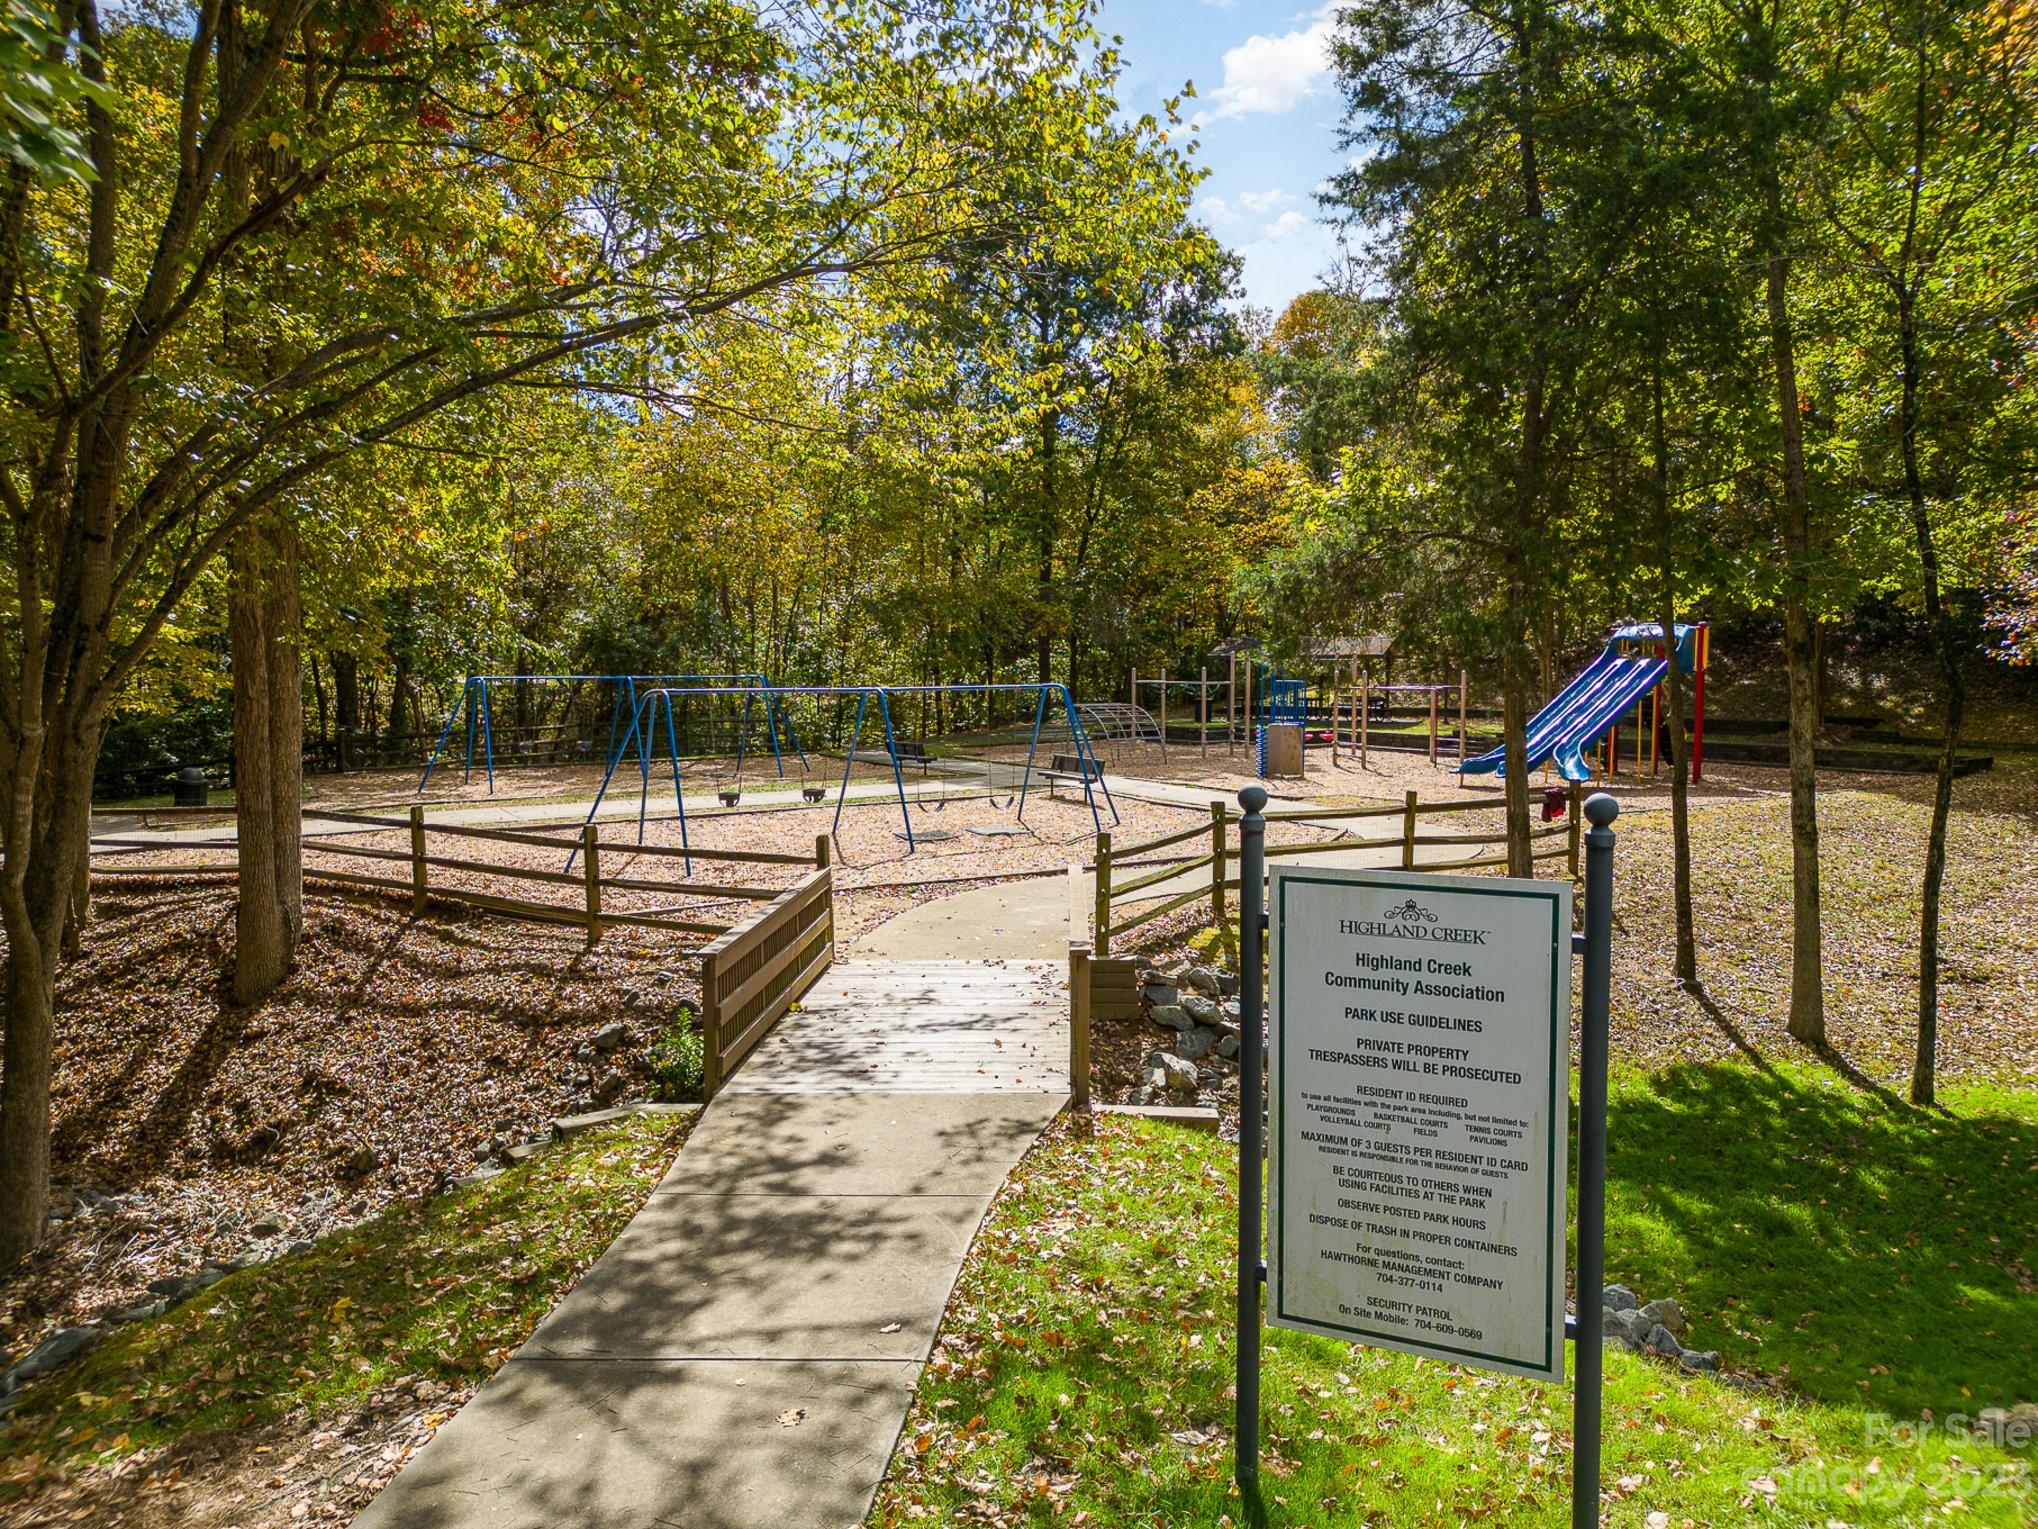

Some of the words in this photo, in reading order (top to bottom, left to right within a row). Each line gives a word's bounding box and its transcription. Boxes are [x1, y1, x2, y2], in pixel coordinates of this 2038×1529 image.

[1339, 919, 1428, 940] HIGHLAND
[1355, 952, 1422, 973] Highland
[1427, 958, 1472, 977] Creek
[1325, 971, 1410, 996] Community
[1413, 980, 1505, 1003] Association
[1344, 1007, 1378, 1022] PARK
[1380, 1010, 1405, 1025] USE
[1408, 1013, 1483, 1033] GUIDELINES
[1356, 1037, 1404, 1054] PRIVATE
[1407, 1043, 1470, 1062] PROPERTY
[1308, 1048, 1388, 1069] TRESPASSERS
[1391, 1058, 1420, 1073] WILL
[1423, 1062, 1439, 1075] BE
[1442, 1064, 1522, 1085] PROSECUTED
[1301, 1091, 1308, 1099] to
[1323, 1094, 1332, 1102] all
[1333, 1095, 1362, 1106] facilities
[1363, 1100, 1379, 1108] with
[1380, 1102, 1391, 1110] the
[1392, 1104, 1409, 1112] park
[1410, 1106, 1426, 1115] area
[1464, 1112, 1477, 1121] but
[1477, 1115, 1490, 1123] not
[1491, 1116, 1518, 1126] limited
[1356, 1085, 1404, 1100] RESIDENT
[1406, 1091, 1416, 1102] ID
[1419, 1093, 1468, 1108] REQUIRED
[1306, 1103, 1356, 1117] PLAYGROUNDS
[1319, 1114, 1362, 1127] VOLLEYBALL
[1363, 1120, 1392, 1132] COURTS
[1373, 1112, 1419, 1125] BASKETBALL
[1420, 1118, 1449, 1129] COURTS
[1413, 1127, 1438, 1138] FIELDS
[1464, 1124, 1492, 1135] TENNIS
[1493, 1128, 1523, 1139] COURTS
[1469, 1134, 1508, 1147] PAVILIONS
[1301, 1130, 1348, 1146] MAXIMUM
[1351, 1137, 1363, 1148] OF
[1365, 1140, 1372, 1150] 3
[1373, 1141, 1411, 1155] GUESTS
[1413, 1146, 1432, 1159] PER
[1435, 1149, 1484, 1166] RESIDENT
[1487, 1157, 1497, 1167] ID
[1500, 1158, 1528, 1172] CARD
[1318, 1145, 1350, 1156] RESIDENT
[1351, 1150, 1358, 1158] IS
[1359, 1151, 1404, 1164] RESPONSIBLE
[1405, 1158, 1419, 1166] FOR
[1420, 1160, 1433, 1169] THE
[1434, 1162, 1469, 1174] BEHAVIOR
[1470, 1167, 1480, 1175] OF
[1481, 1168, 1509, 1180] GUESTS
[1333, 1165, 1345, 1176] BE
[1347, 1167, 1403, 1185] COURTEOUS
[1406, 1176, 1419, 1187] TO
[1421, 1178, 1460, 1193] OTHERS
[1462, 1184, 1492, 1198] WHEN
[1338, 1177, 1367, 1191] USING
[1370, 1182, 1421, 1199] FACILITIES
[1422, 1190, 1435, 1201] AT
[1437, 1192, 1457, 1205] THE
[1459, 1196, 1486, 1210] PARK
[1337, 1198, 1381, 1214] OBSERVE
[1383, 1205, 1421, 1220] POSTED
[1423, 1211, 1450, 1225] PARK
[1451, 1216, 1486, 1231] HOURS
[1309, 1213, 1349, 1229] DISPOSE
[1350, 1220, 1363, 1231] OF
[1365, 1222, 1397, 1237] TRASH
[1400, 1228, 1410, 1239] IN
[1412, 1230, 1451, 1246] PROPER
[1454, 1237, 1518, 1257] CONTAINERS
[1356, 1242, 1372, 1254] For
[1373, 1247, 1423, 1265] questions,
[1425, 1256, 1465, 1270] contact:
[1320, 1249, 1380, 1269] HAWTHORNE
[1382, 1260, 1452, 1281] MANAGEMENT
[1453, 1272, 1504, 1290] COMPANY
[1376, 1272, 1443, 1293] 704-377-0114
[1338, 1303, 1351, 1315] On
[1353, 1306, 1372, 1319] Site
[1374, 1310, 1409, 1326] Mobile:
[1414, 1318, 1483, 1340] 704-609-0569
[1366, 1296, 1413, 1314] SECURITY
[1415, 1305, 1453, 1321] PATROL
